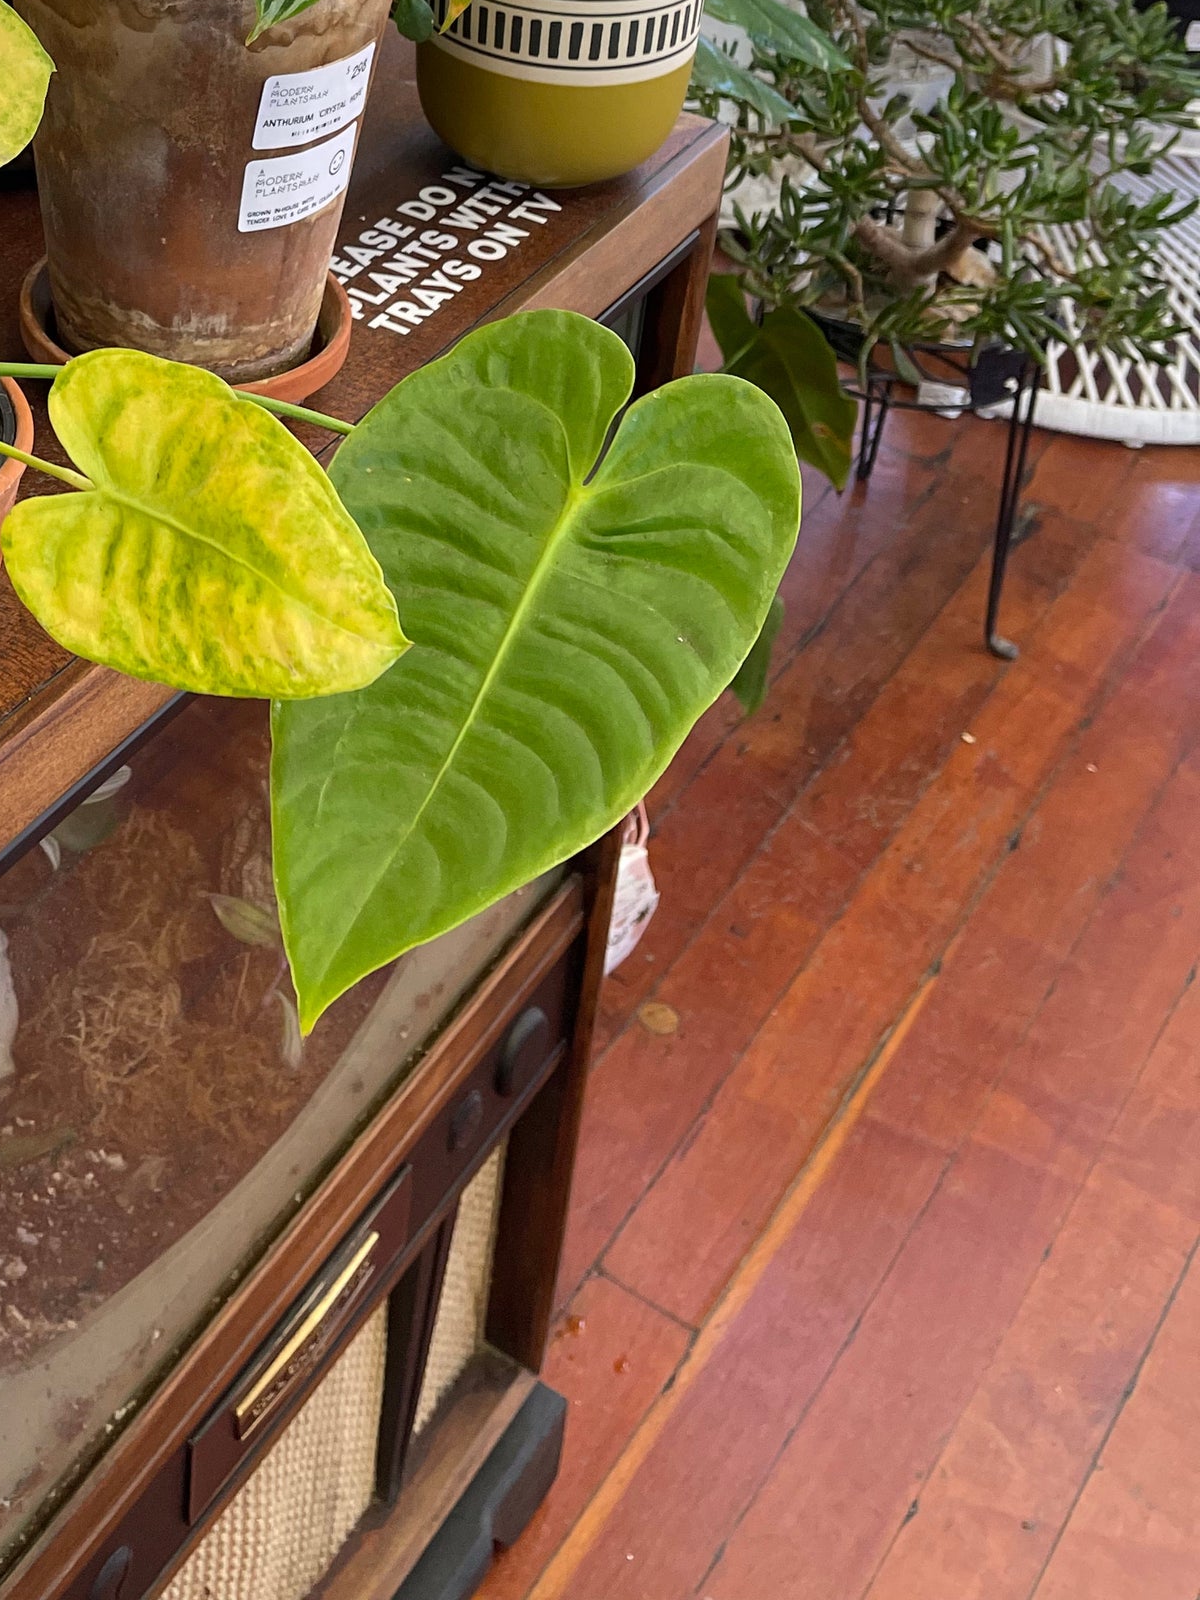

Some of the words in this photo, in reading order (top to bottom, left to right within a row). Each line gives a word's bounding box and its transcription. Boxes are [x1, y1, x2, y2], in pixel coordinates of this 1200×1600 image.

[269, 90, 329, 108] PLANTSMAN
[270, 85, 315, 98] MODERN
[262, 113, 315, 128] ANTHURIUM
[255, 171, 304, 188] MODERN
[255, 173, 320, 198] PLANTSMAN
[247, 209, 272, 218] GROWN
[274, 201, 300, 214] IN-HOUSE
[246, 217, 271, 225] TENDER
[272, 213, 288, 222] LOVE
[329, 216, 416, 286] EASE
[396, 185, 457, 222] DO
[347, 229, 459, 321] PLANTS
[438, 181, 531, 231] WITH
[367, 258, 483, 336] TRAYS
[466, 221, 531, 261] ON
[507, 192, 563, 225] TV
